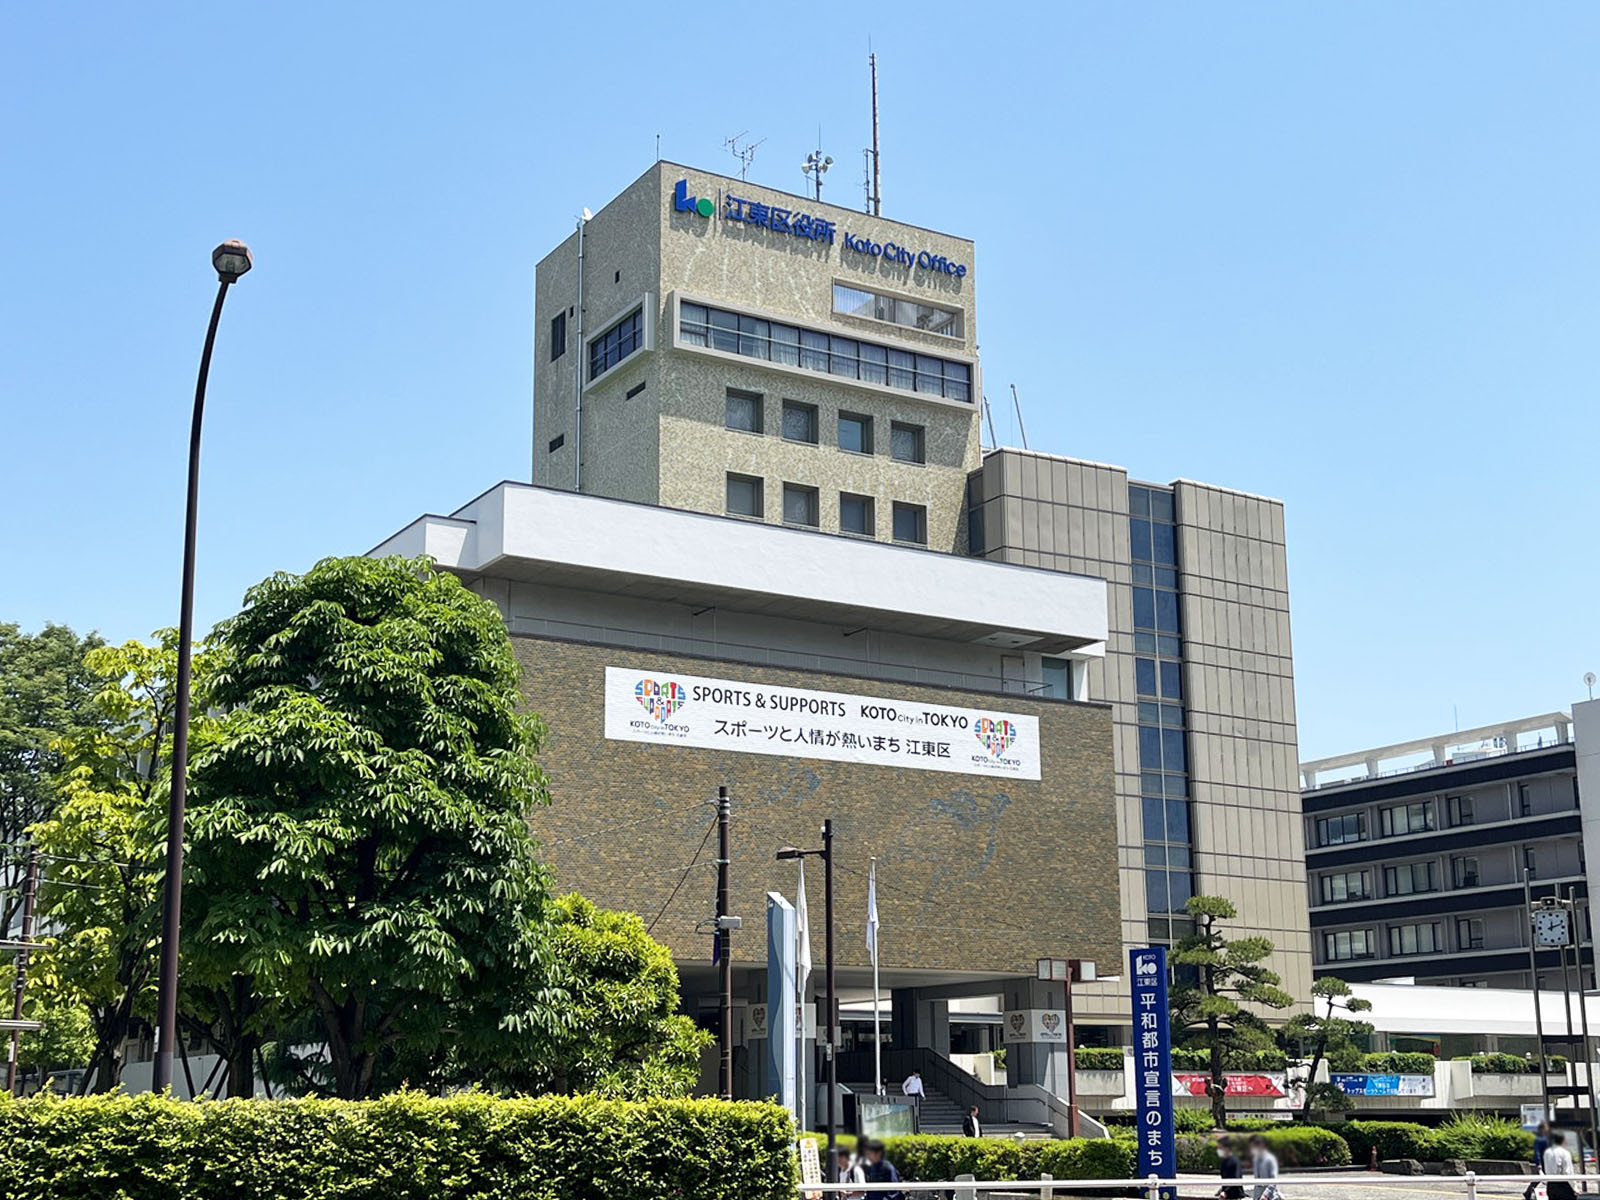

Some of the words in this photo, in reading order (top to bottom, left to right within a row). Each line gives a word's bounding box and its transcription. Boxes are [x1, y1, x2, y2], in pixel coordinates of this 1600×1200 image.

[725, 194, 837, 245] 江東区役所
[844, 231, 882, 257] Koto
[883, 242, 916, 269] City
[917, 250, 967, 278] Office
[634, 679, 686, 700] SPORTS
[692, 685, 751, 707] SPORTS
[755, 693, 766, 709] &
[769, 694, 846, 717] SUPPORTS
[860, 705, 897, 721] KOTO
[897, 714, 915, 725] City
[922, 711, 969, 729] TOKYO
[630, 720, 651, 729] KOTO
[664, 723, 690, 733] TOKYO
[714, 719, 901, 752] スポーツと人情が熱いまち
[905, 738, 951, 758] 江東区
[1136, 977, 1158, 987] 江東区
[1140, 992, 1164, 1167] 平和都市宣言のまち
